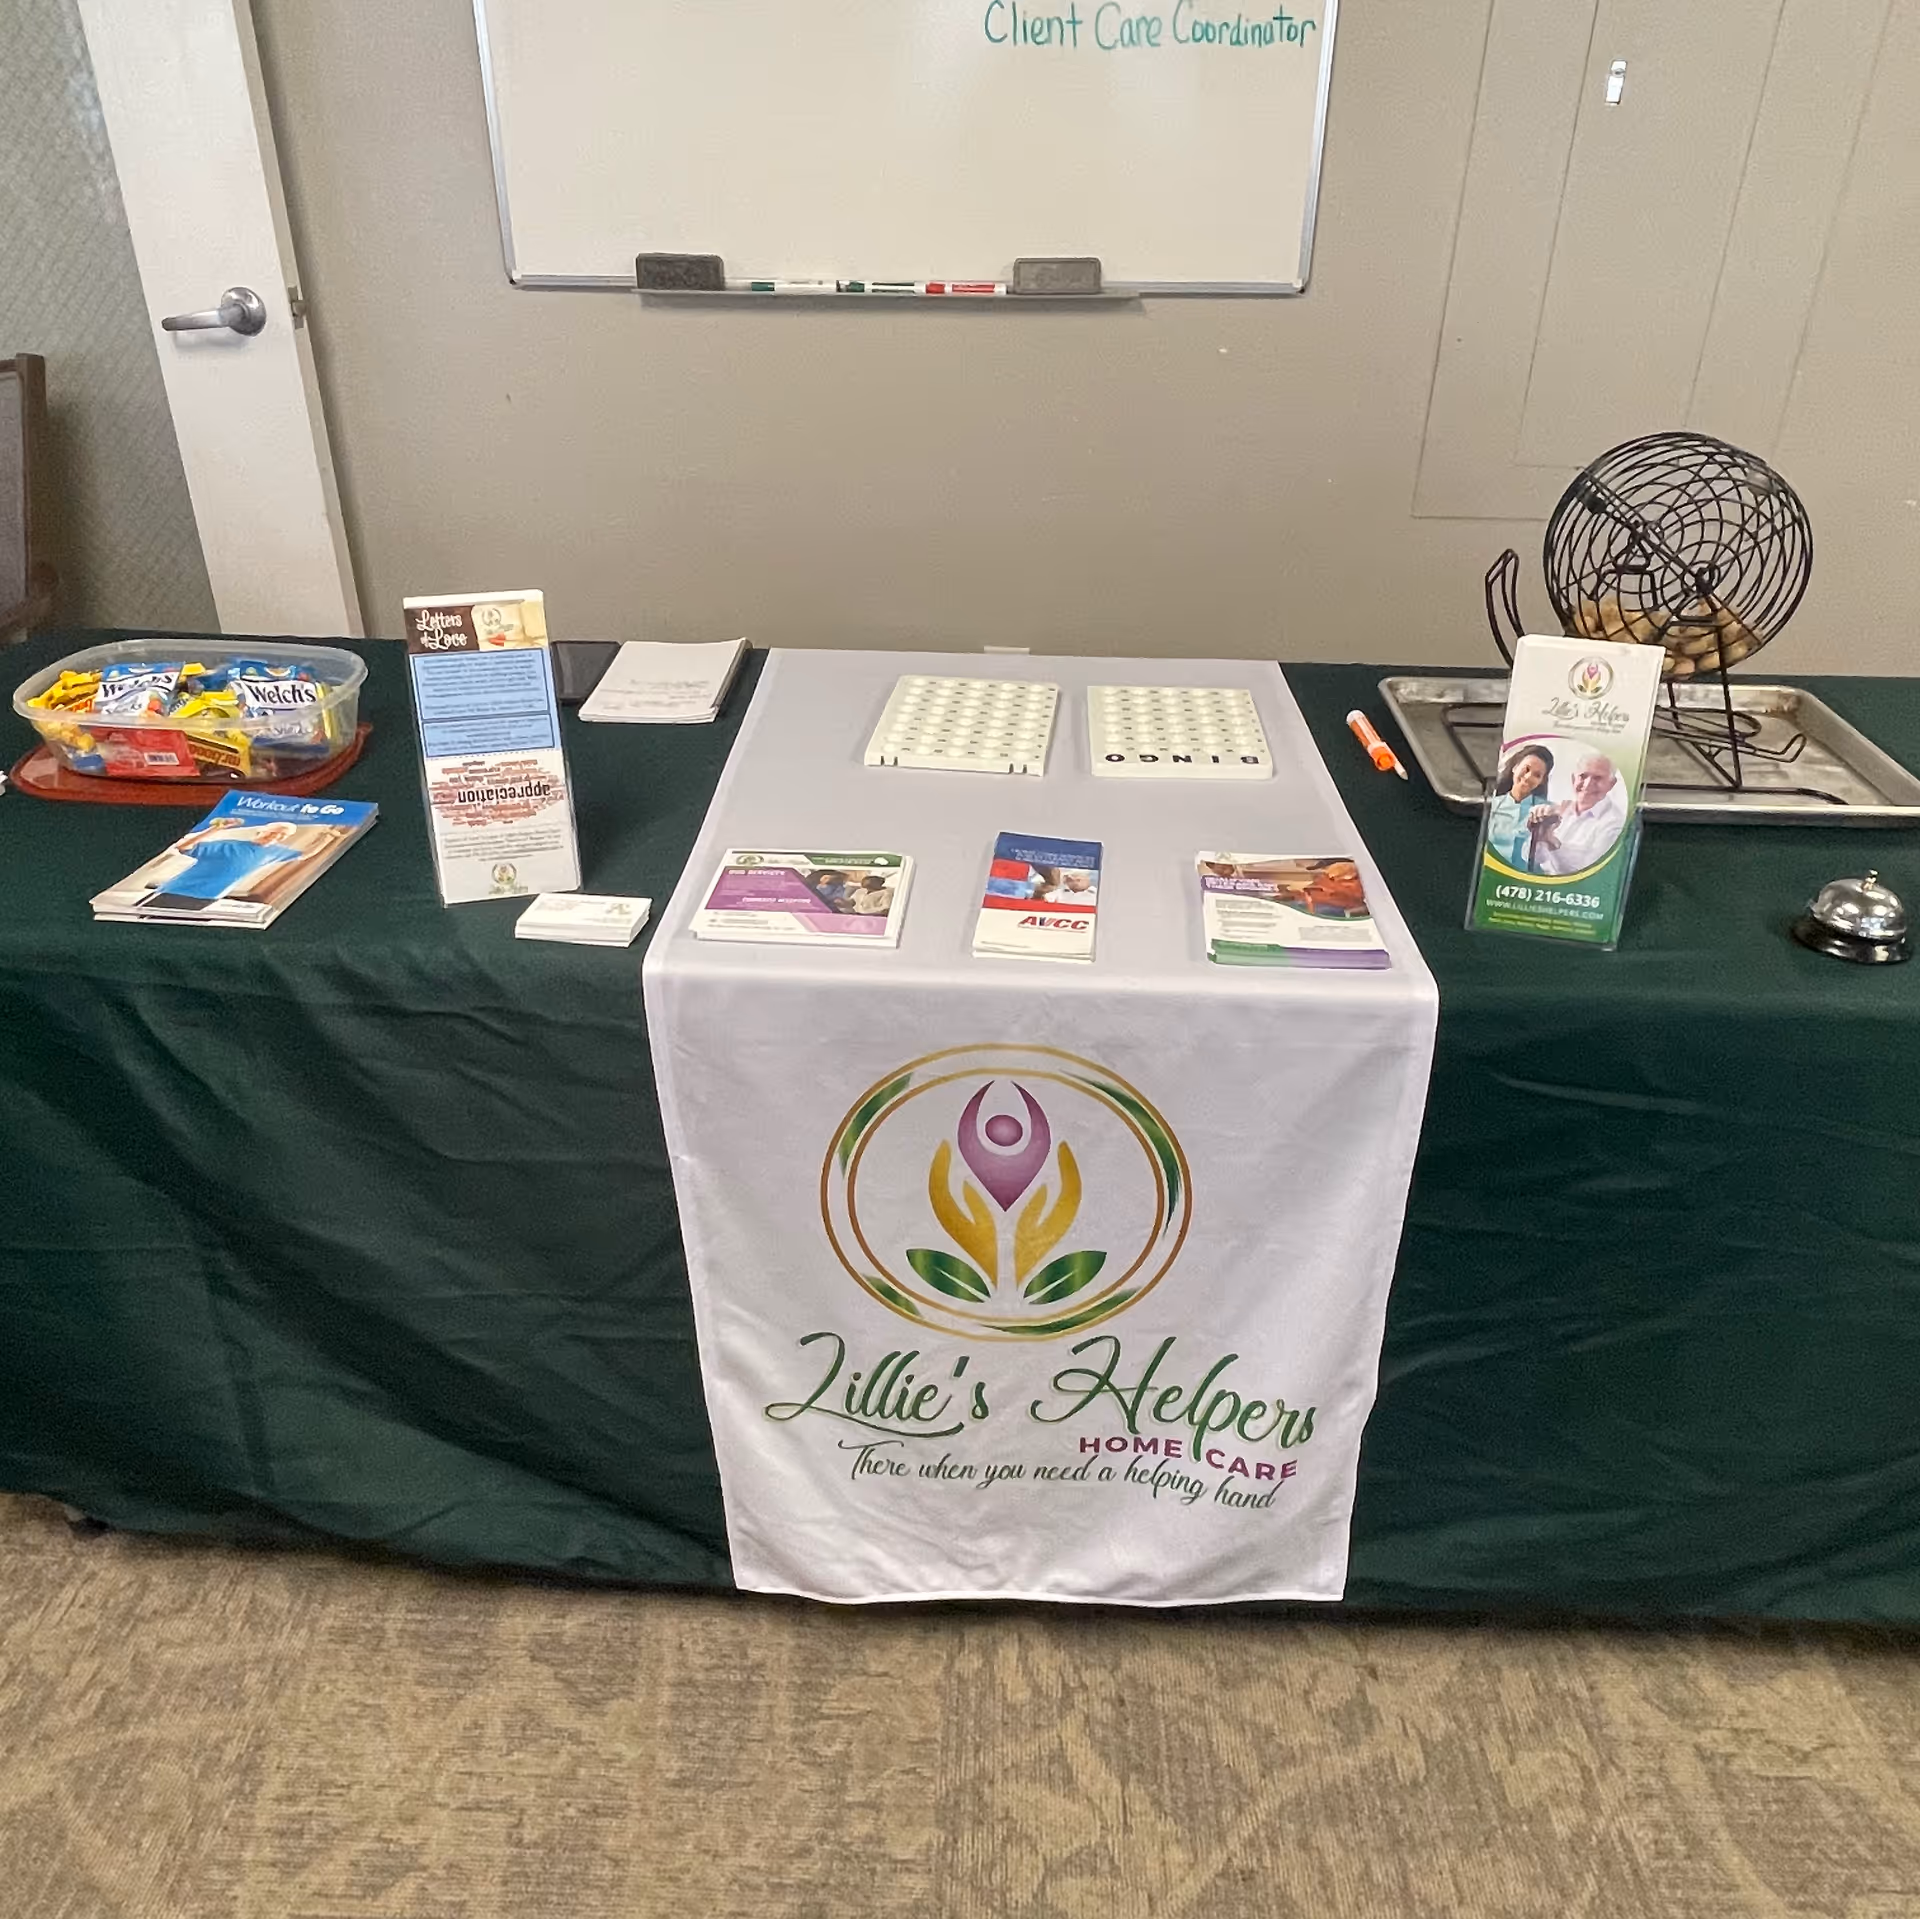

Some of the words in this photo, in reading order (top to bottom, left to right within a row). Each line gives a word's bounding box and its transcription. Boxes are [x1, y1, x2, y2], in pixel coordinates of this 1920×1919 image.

[984, 0, 1083, 47] Client
[1095, 2, 1163, 50] Care
[1172, 0, 1316, 48] Coordinator
[415, 610, 462, 631] Letters
[428, 629, 468, 650] Love
[248, 684, 317, 704] Welch's
[458, 781, 551, 806] appreciation
[237, 796, 300, 812] Workout
[300, 803, 320, 815] to
[320, 804, 344, 815] Go
[1495, 885, 1532, 902] (478)
[1534, 890, 1600, 908] 216-6336
[1019, 916, 1090, 931] AVCC
[764, 1331, 990, 1438] Lillie's
[1029, 1335, 1317, 1461] Helpers
[1079, 1436, 1183, 1459] HOME
[1205, 1448, 1298, 1481] CARE
[837, 1439, 911, 1480] There
[918, 1452, 978, 1480] when
[975, 1462, 1027, 1490] you
[1033, 1454, 1092, 1481] need
[1098, 1465, 1117, 1482] a
[1124, 1454, 1208, 1506] helping
[1213, 1475, 1285, 1509] hand
